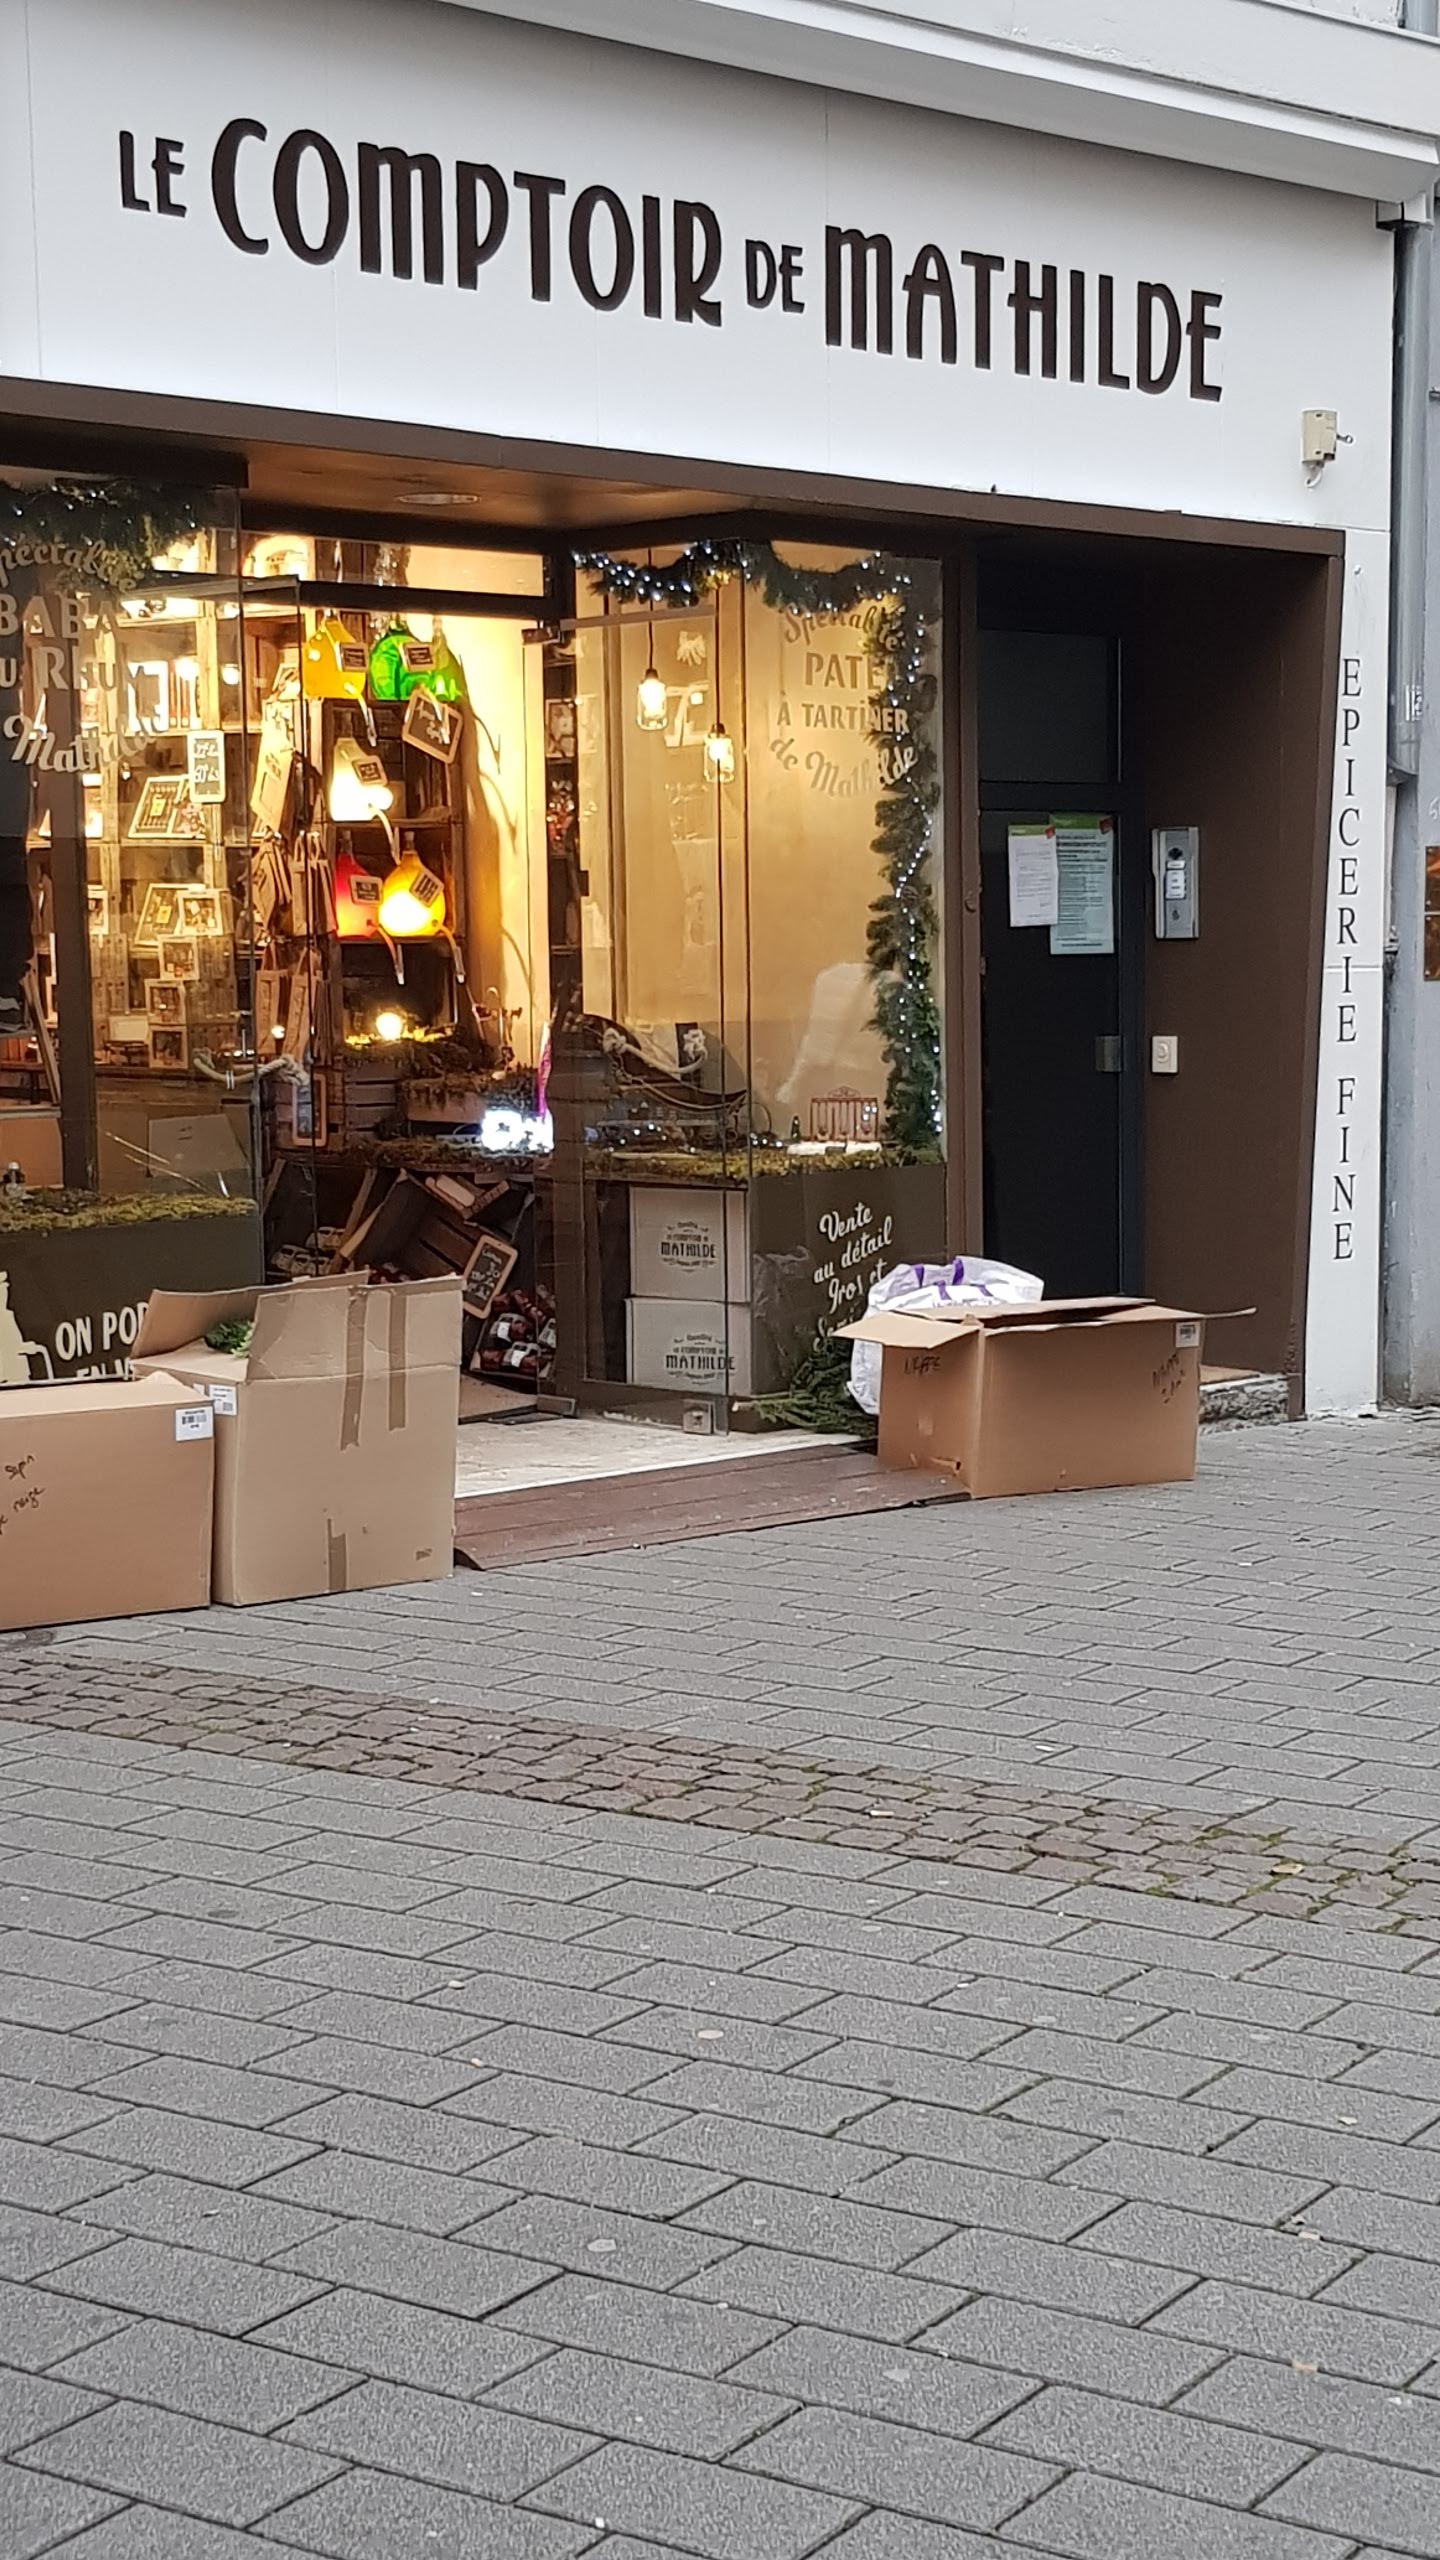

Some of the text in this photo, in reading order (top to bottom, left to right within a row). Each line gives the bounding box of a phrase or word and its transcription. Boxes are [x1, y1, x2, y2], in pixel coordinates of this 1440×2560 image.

[118, 117, 1223, 403] LE COMPTOIR DE MATHILDE
[0, 593, 119, 640] BABA
[0, 657, 17, 688] U
[769, 737, 918, 798] de Mathlde
[1331, 658, 1362, 1261] EPICERIE FINE
[819, 1202, 873, 1242] Vente
[661, 1242, 716, 1258] MATHILDE
[814, 1215, 892, 1284] au détail
[55, 1316, 93, 1361] ON
[665, 1355, 736, 1370] MATHILDE
